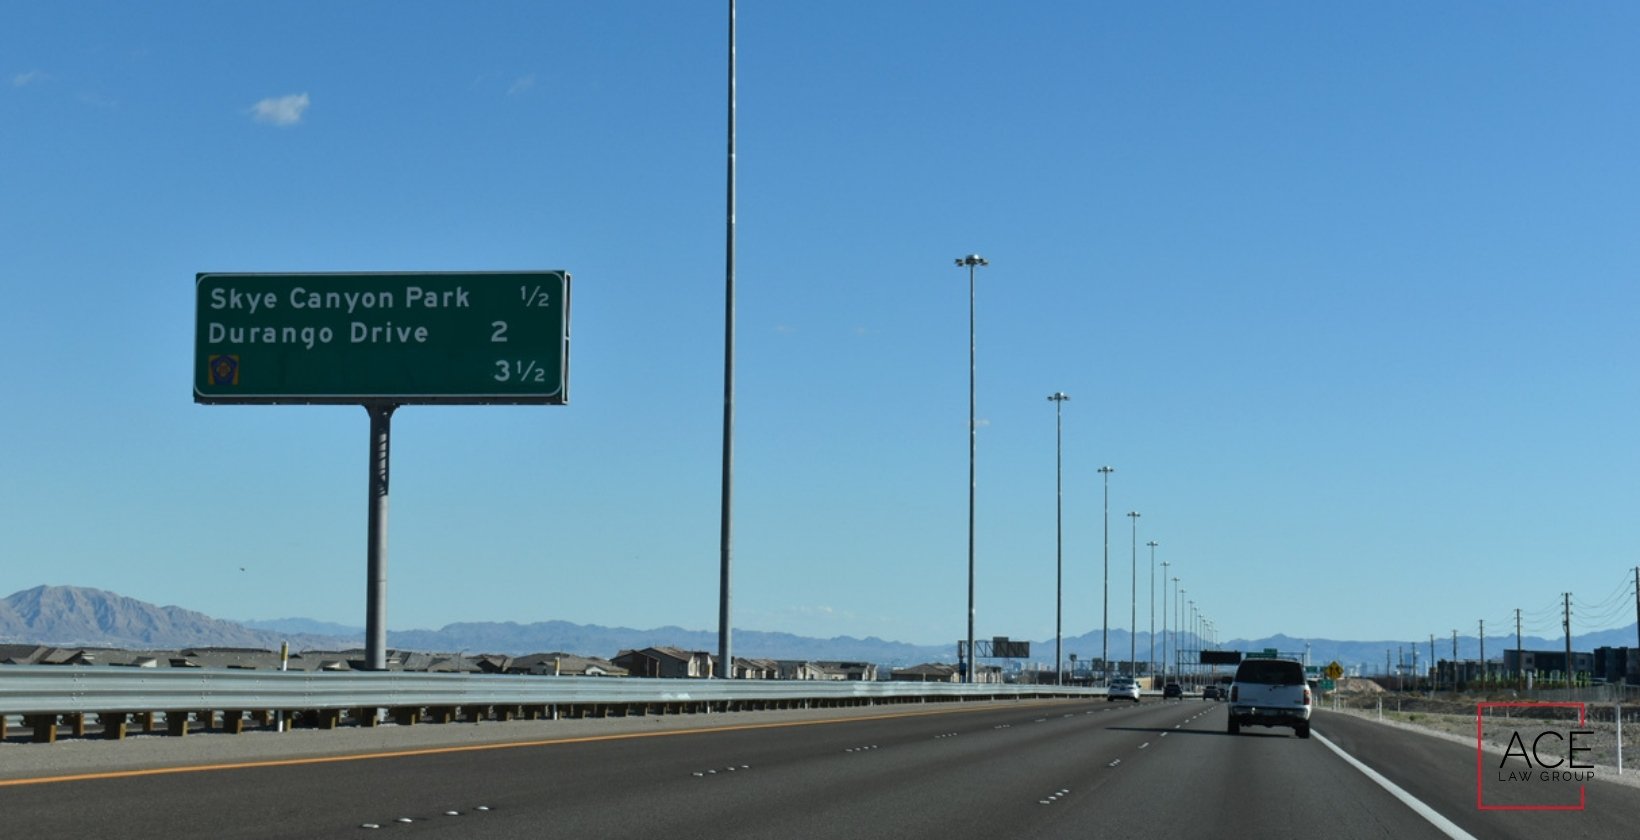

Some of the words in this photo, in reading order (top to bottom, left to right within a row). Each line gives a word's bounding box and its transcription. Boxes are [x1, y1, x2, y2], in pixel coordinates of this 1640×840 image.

[210, 287, 278, 313] Skye
[290, 287, 394, 313] Canyon
[406, 286, 470, 308] Park
[208, 322, 333, 350] Durango
[350, 321, 429, 344] Drive
[491, 321, 508, 343] 2
